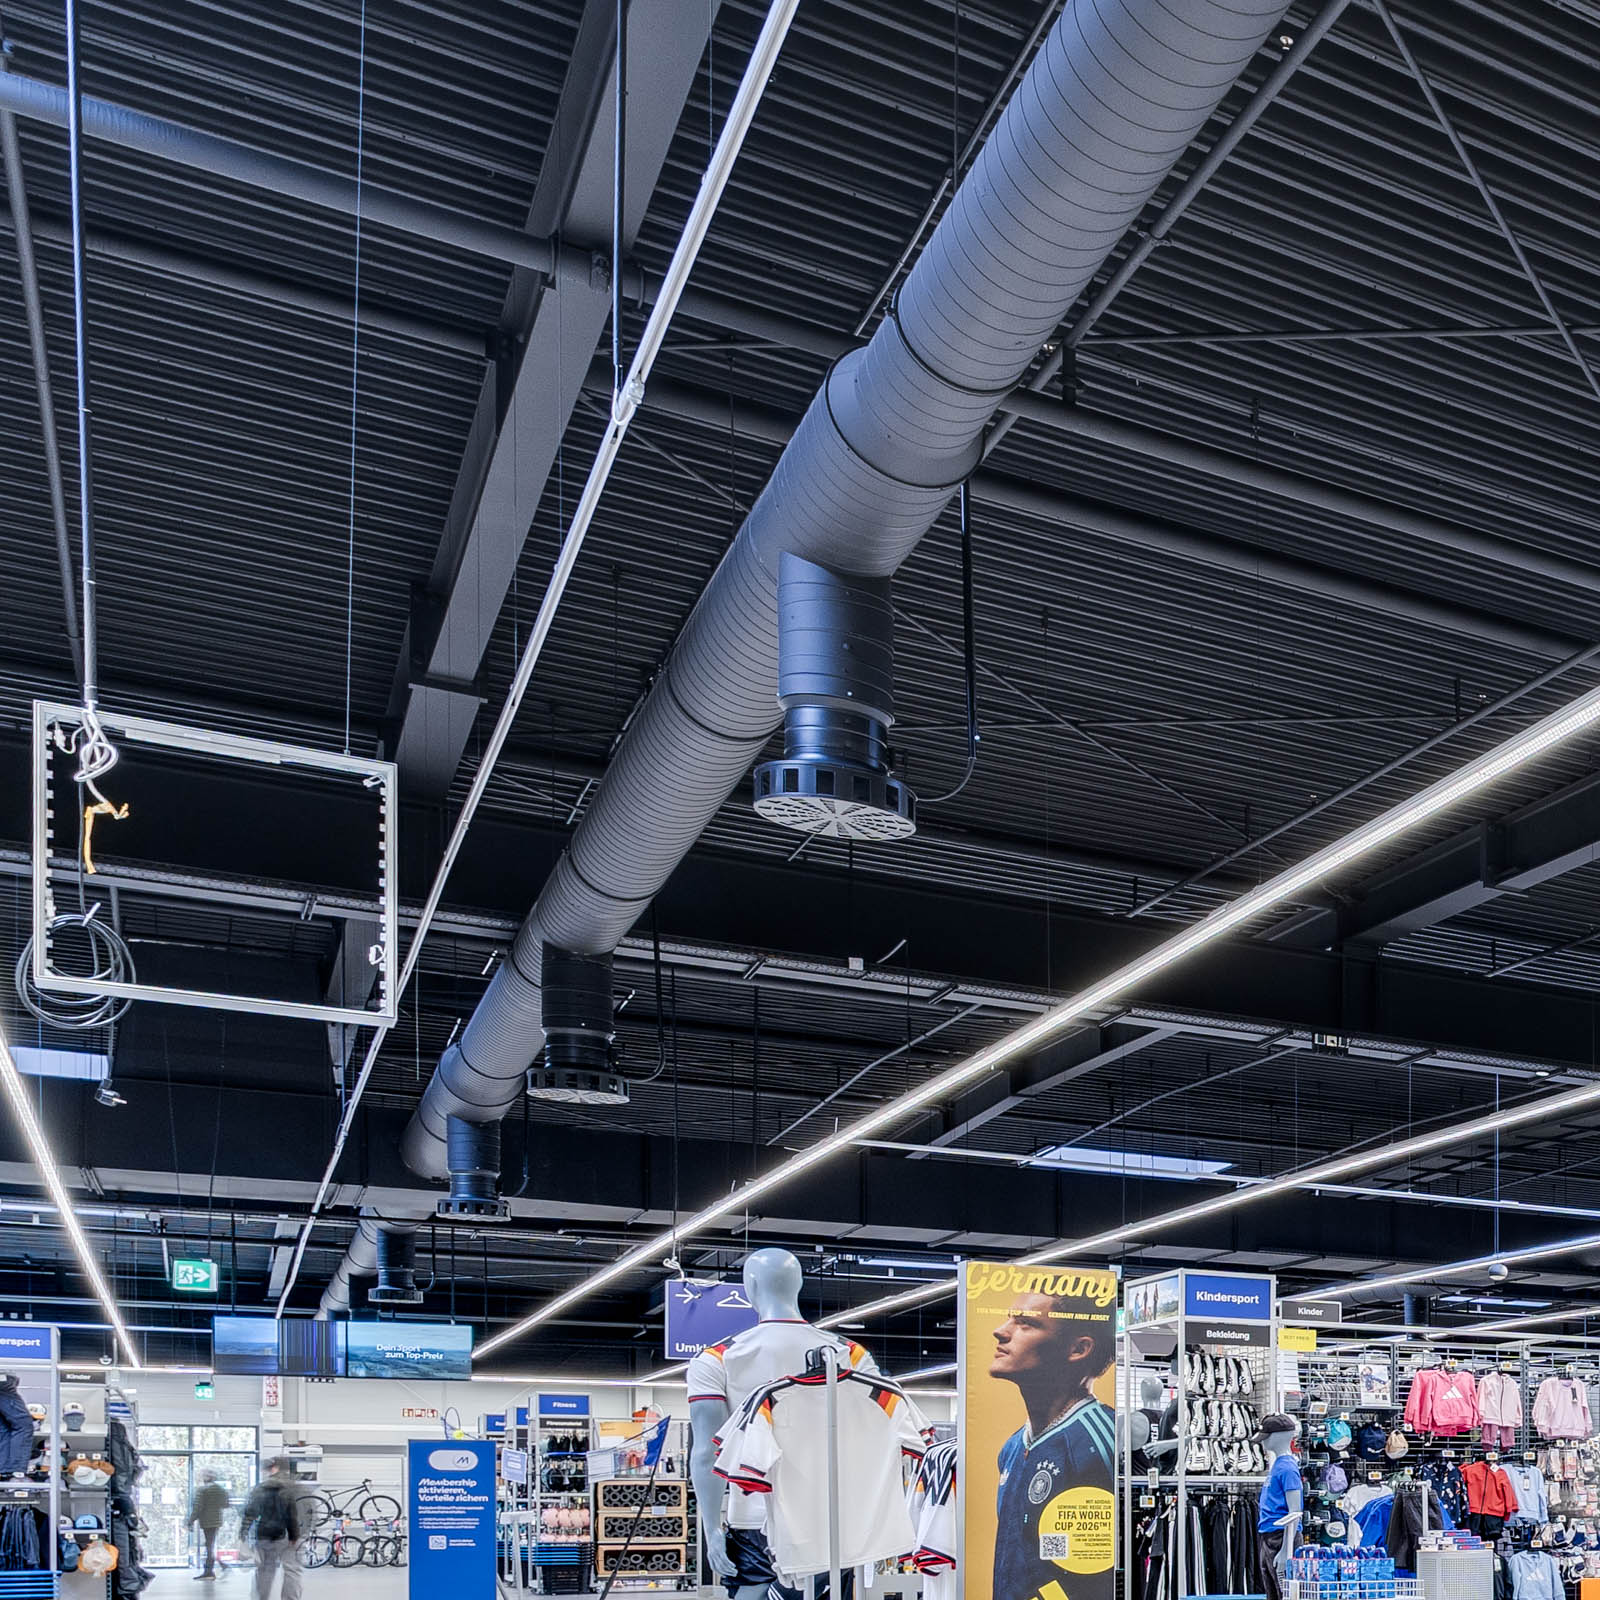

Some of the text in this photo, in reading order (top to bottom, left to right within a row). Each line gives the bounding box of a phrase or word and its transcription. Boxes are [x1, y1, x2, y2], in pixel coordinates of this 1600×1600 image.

[967, 1261, 1117, 1307] Germany
[1196, 1291, 1259, 1304] Kindersport
[1298, 1307, 1324, 1316] Kinder
[1206, 1330, 1250, 1341] Bekleidung
[0, 1338, 40, 1347] ersport
[418, 1478, 477, 1488] Membership
[418, 1487, 467, 1495] aktivieren,
[418, 1494, 489, 1502] Vorteile sichern
[1058, 1511, 1112, 1520] FIFA WORLD
[1055, 1522, 1073, 1531] CUP
